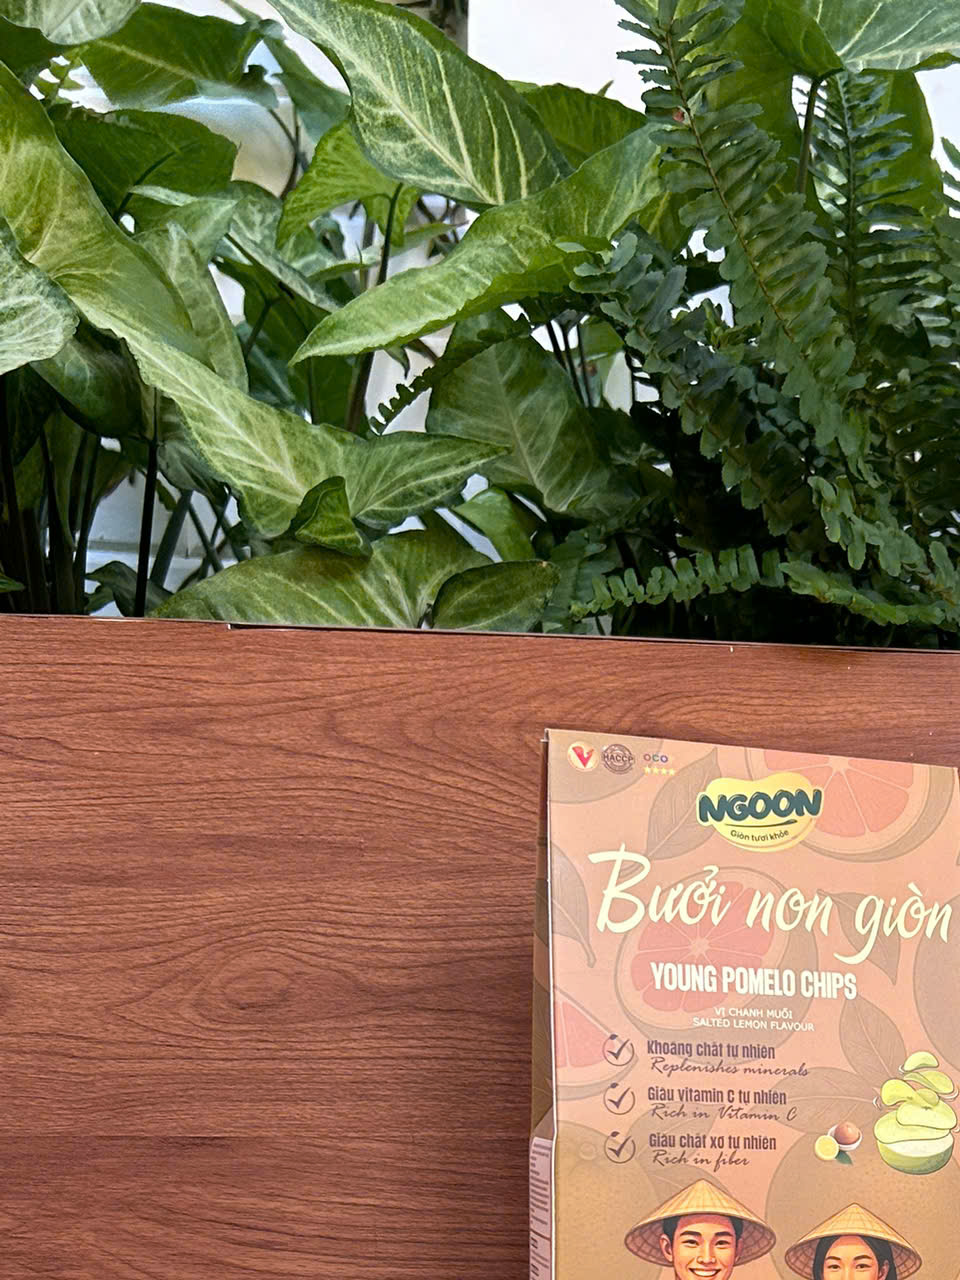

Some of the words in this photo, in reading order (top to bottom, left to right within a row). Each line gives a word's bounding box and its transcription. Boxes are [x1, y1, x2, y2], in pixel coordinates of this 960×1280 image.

[603, 753, 634, 763] HACCP
[699, 788, 822, 822] NGOON
[730, 829, 750, 840] Giòn
[751, 832, 769, 842] tươi
[588, 842, 731, 933] Bưởi
[745, 887, 833, 936] non
[834, 882, 952, 964] giòn
[650, 962, 717, 993] YOUNG
[722, 966, 796, 997] POMELO
[800, 971, 857, 1000] CHIPS
[728, 1007, 764, 1018] CHANH
[693, 1017, 730, 1028] SALTED
[733, 1018, 768, 1029] LEMON
[770, 1020, 815, 1032] FLAVOUR
[650, 1056, 739, 1077] Replenishes
[744, 1063, 810, 1076] minerals
[678, 1087, 724, 1103] vitamin
[727, 1089, 735, 1104] C
[650, 1102, 687, 1120] Rich
[692, 1107, 710, 1119] in
[718, 1104, 780, 1120] Vitamin
[786, 1106, 798, 1121] C
[652, 1149, 688, 1167] Rich
[693, 1154, 711, 1166] in
[712, 1150, 750, 1172] fiber
